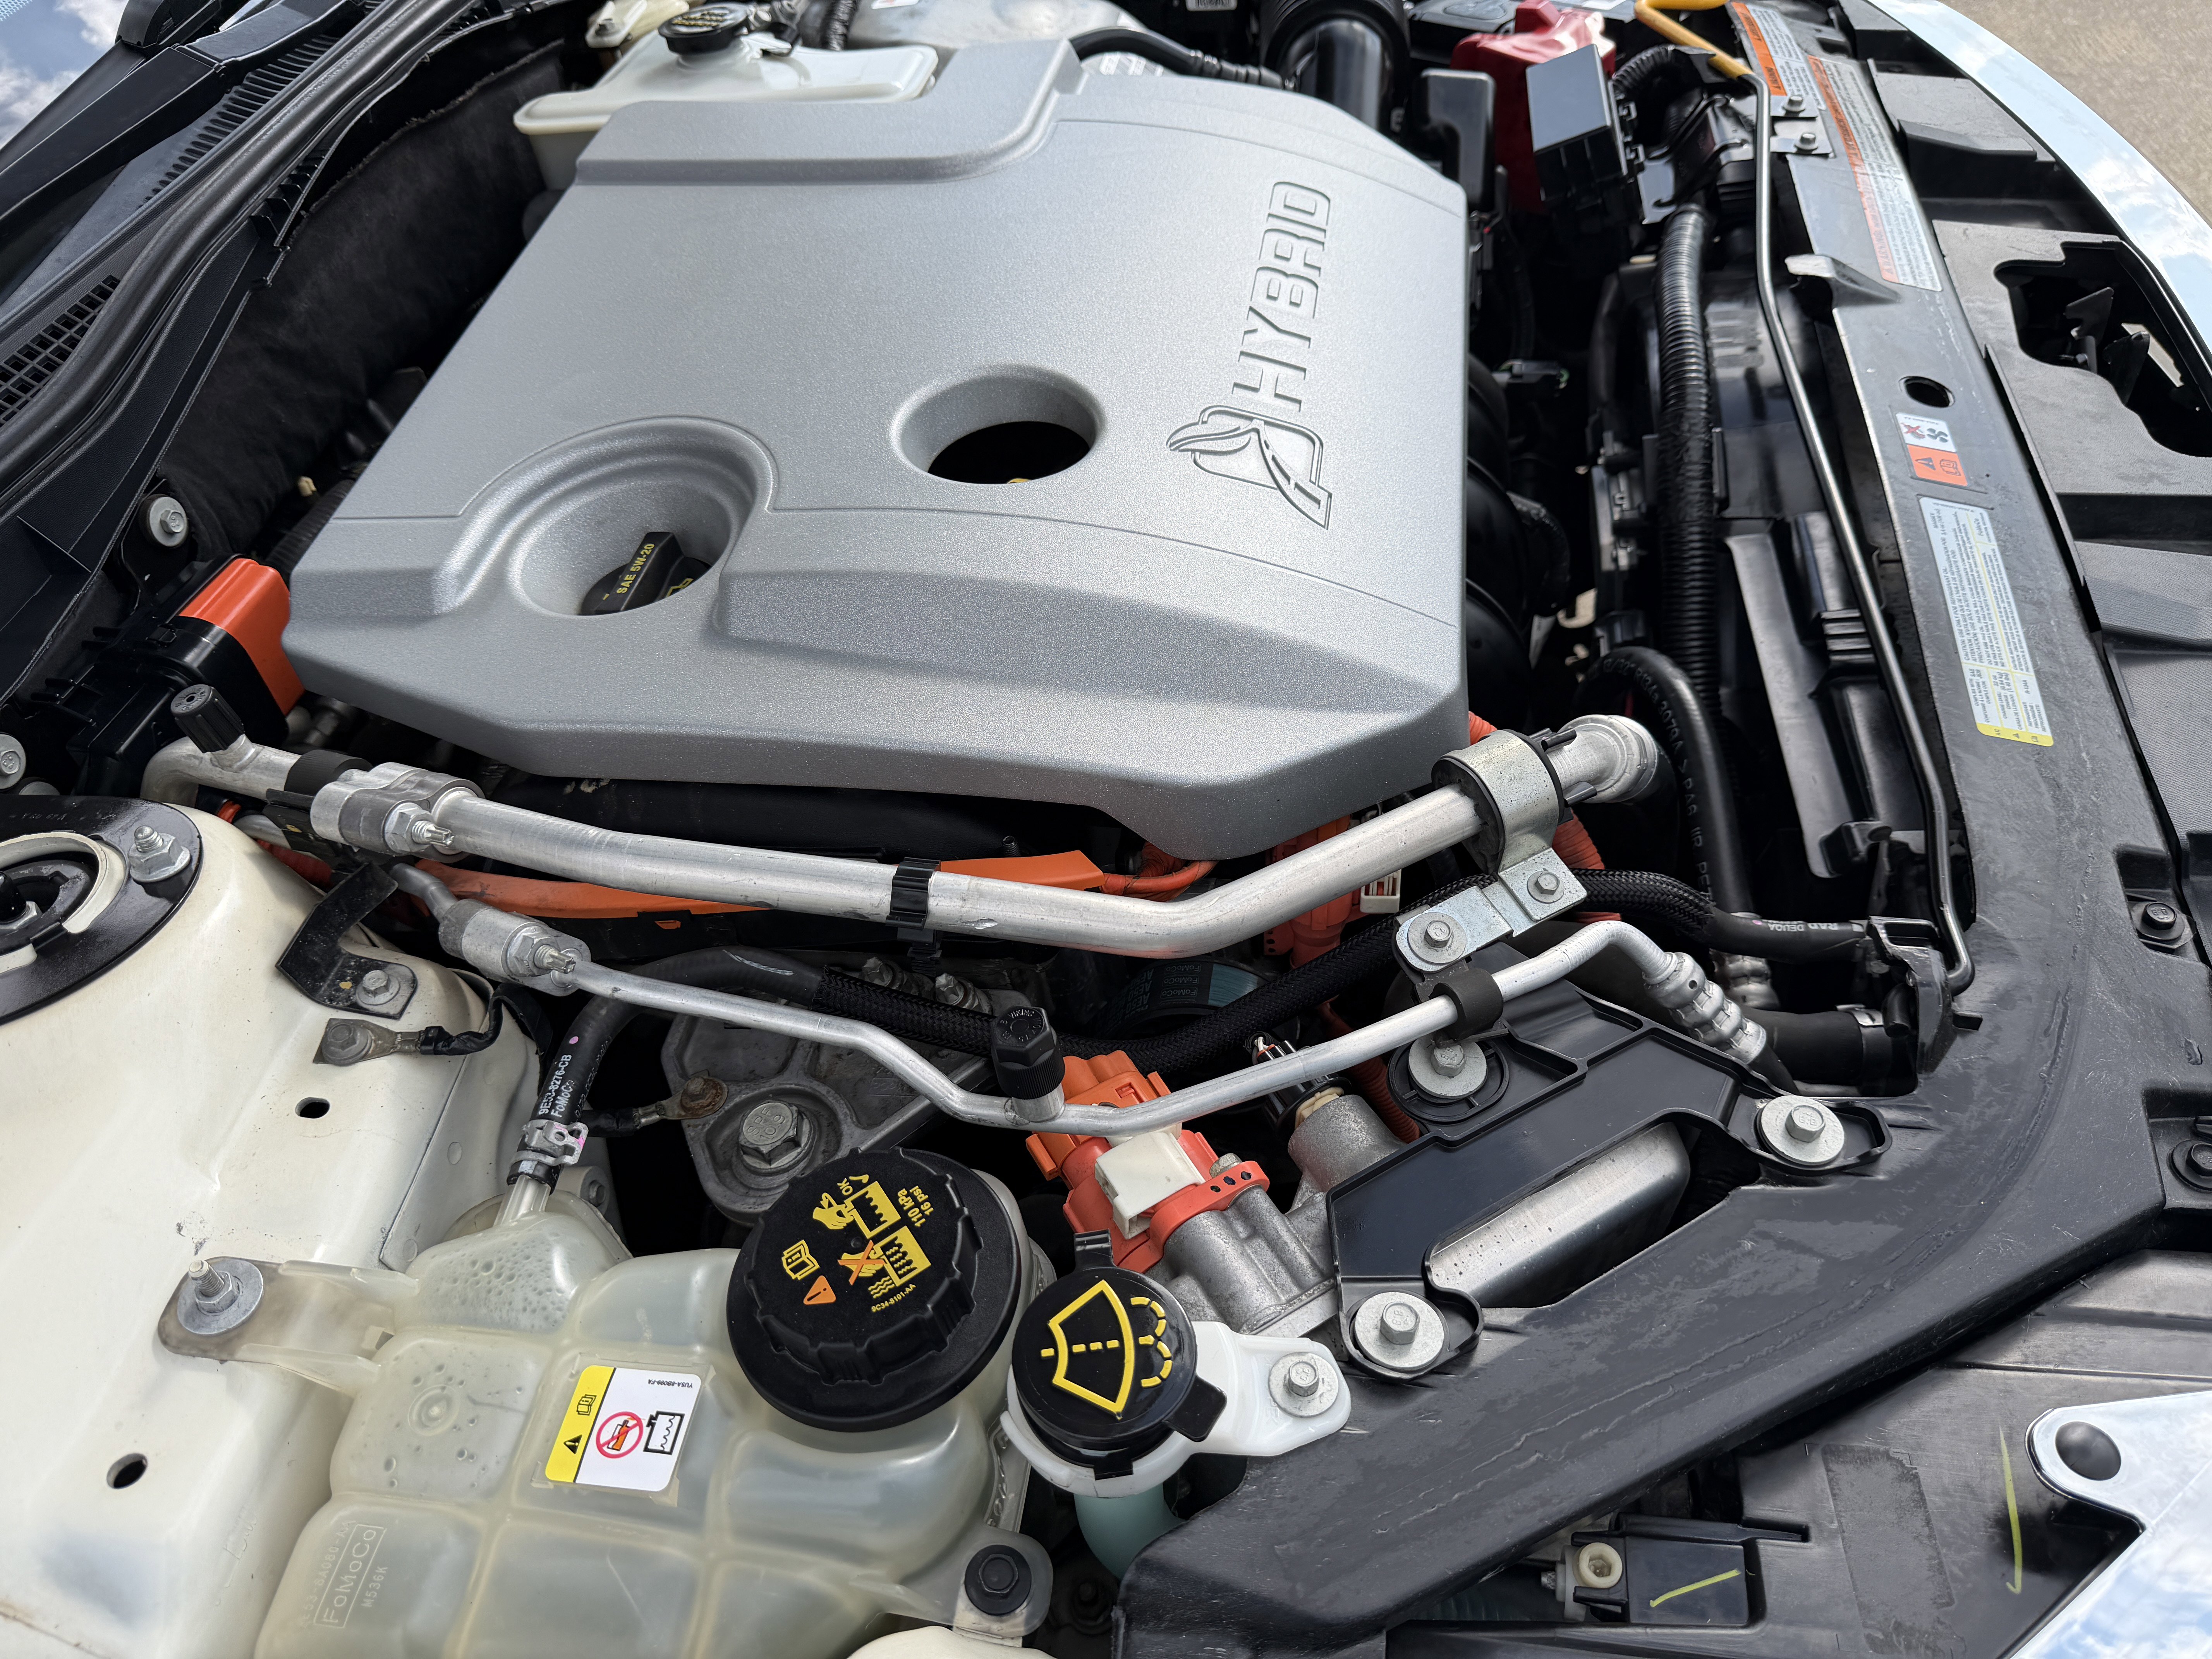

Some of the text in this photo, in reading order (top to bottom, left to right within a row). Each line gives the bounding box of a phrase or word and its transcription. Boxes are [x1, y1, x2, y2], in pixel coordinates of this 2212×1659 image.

[1232, 181, 1331, 412] HYBRID
[617, 544, 655, 594] SAE 5W-20
[1007, 1008, 1034, 1019] VIKING
[837, 1178, 854, 1196] OK
[909, 1185, 934, 1216] 16 psi
[897, 1188, 926, 1227] 110 kPa
[871, 1284, 916, 1312] 9C34-8101-AA
[322, 1529, 376, 1623] FoMoCo
[361, 1566, 388, 1607] M536K
